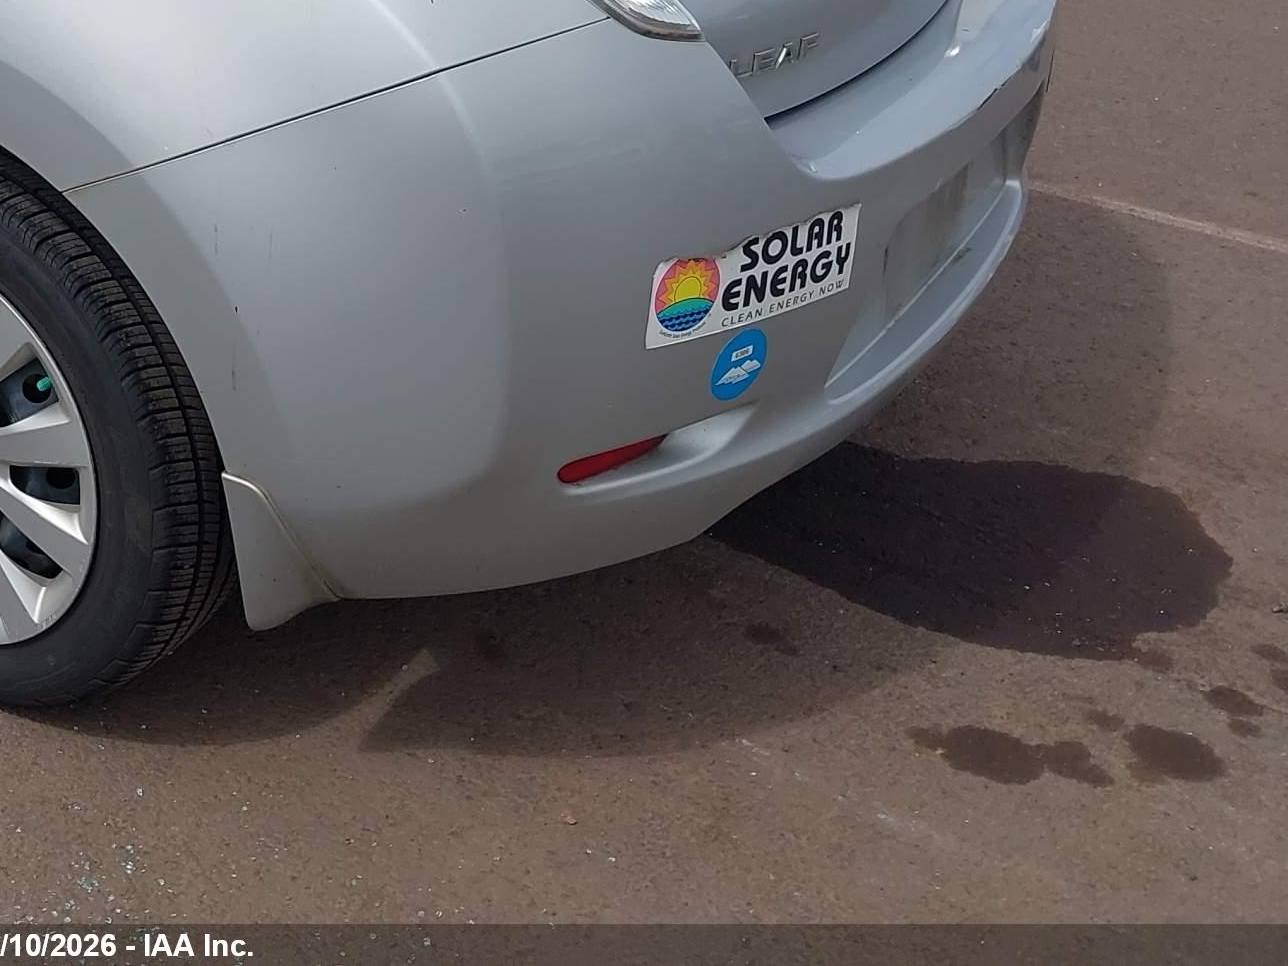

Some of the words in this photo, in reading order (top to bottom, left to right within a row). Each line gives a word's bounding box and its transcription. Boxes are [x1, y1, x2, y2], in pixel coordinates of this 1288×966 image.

[740, 210, 843, 273] SOLAR
[721, 242, 851, 311] ENERGY
[721, 307, 763, 327] CLEAN
[769, 290, 814, 314] ENERGY
[818, 278, 845, 296] NOW
